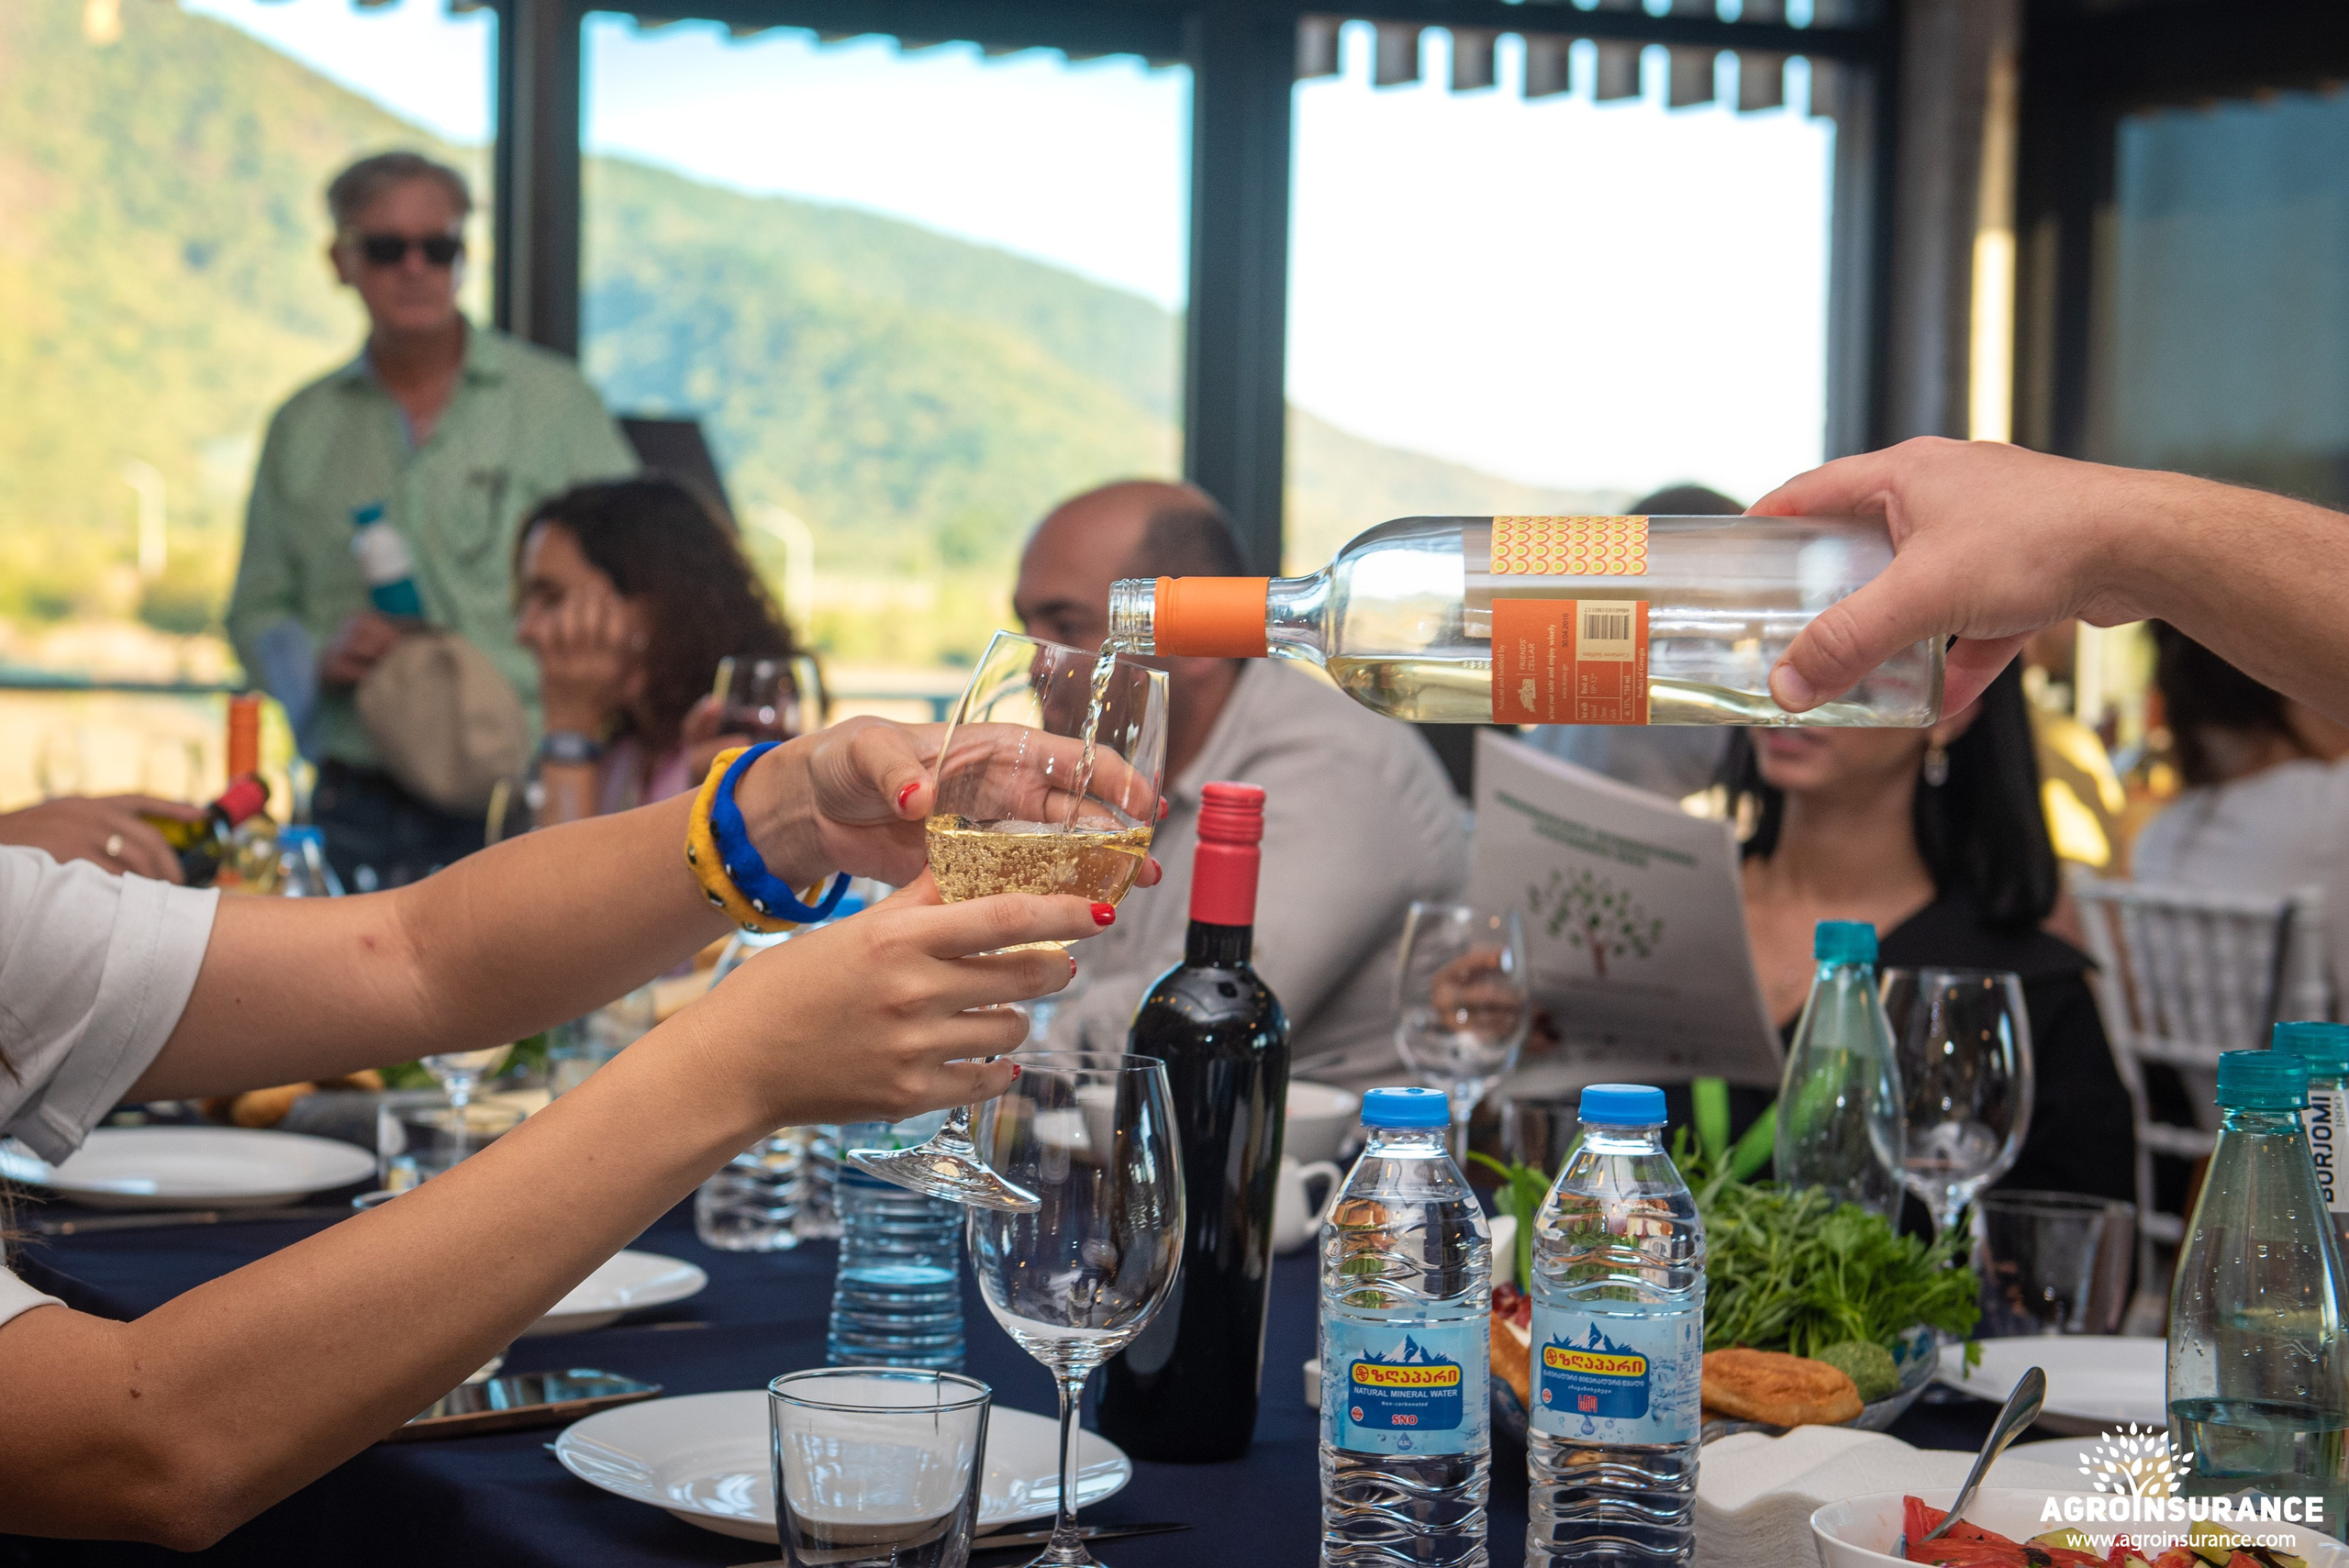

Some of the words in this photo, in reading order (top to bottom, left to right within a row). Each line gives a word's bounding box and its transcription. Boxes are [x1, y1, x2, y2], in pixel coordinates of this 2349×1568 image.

[1546, 624, 1557, 645] wisely
[1497, 644, 1508, 653] by
[1497, 654, 1506, 676] bottled
[1547, 648, 1557, 666] enjoy
[1637, 647, 1646, 671] Georgia
[1547, 667, 1555, 678] and
[1547, 680, 1555, 693] taste
[2333, 1096, 2345, 1128] 1890
[1371, 1368, 1457, 1384] ზღაპარი
[1353, 1386, 1388, 1397] NATURAL
[1390, 1390, 1429, 1398] MINERAL
[1430, 1389, 1458, 1397] WATER
[1392, 1414, 1418, 1425] SNO
